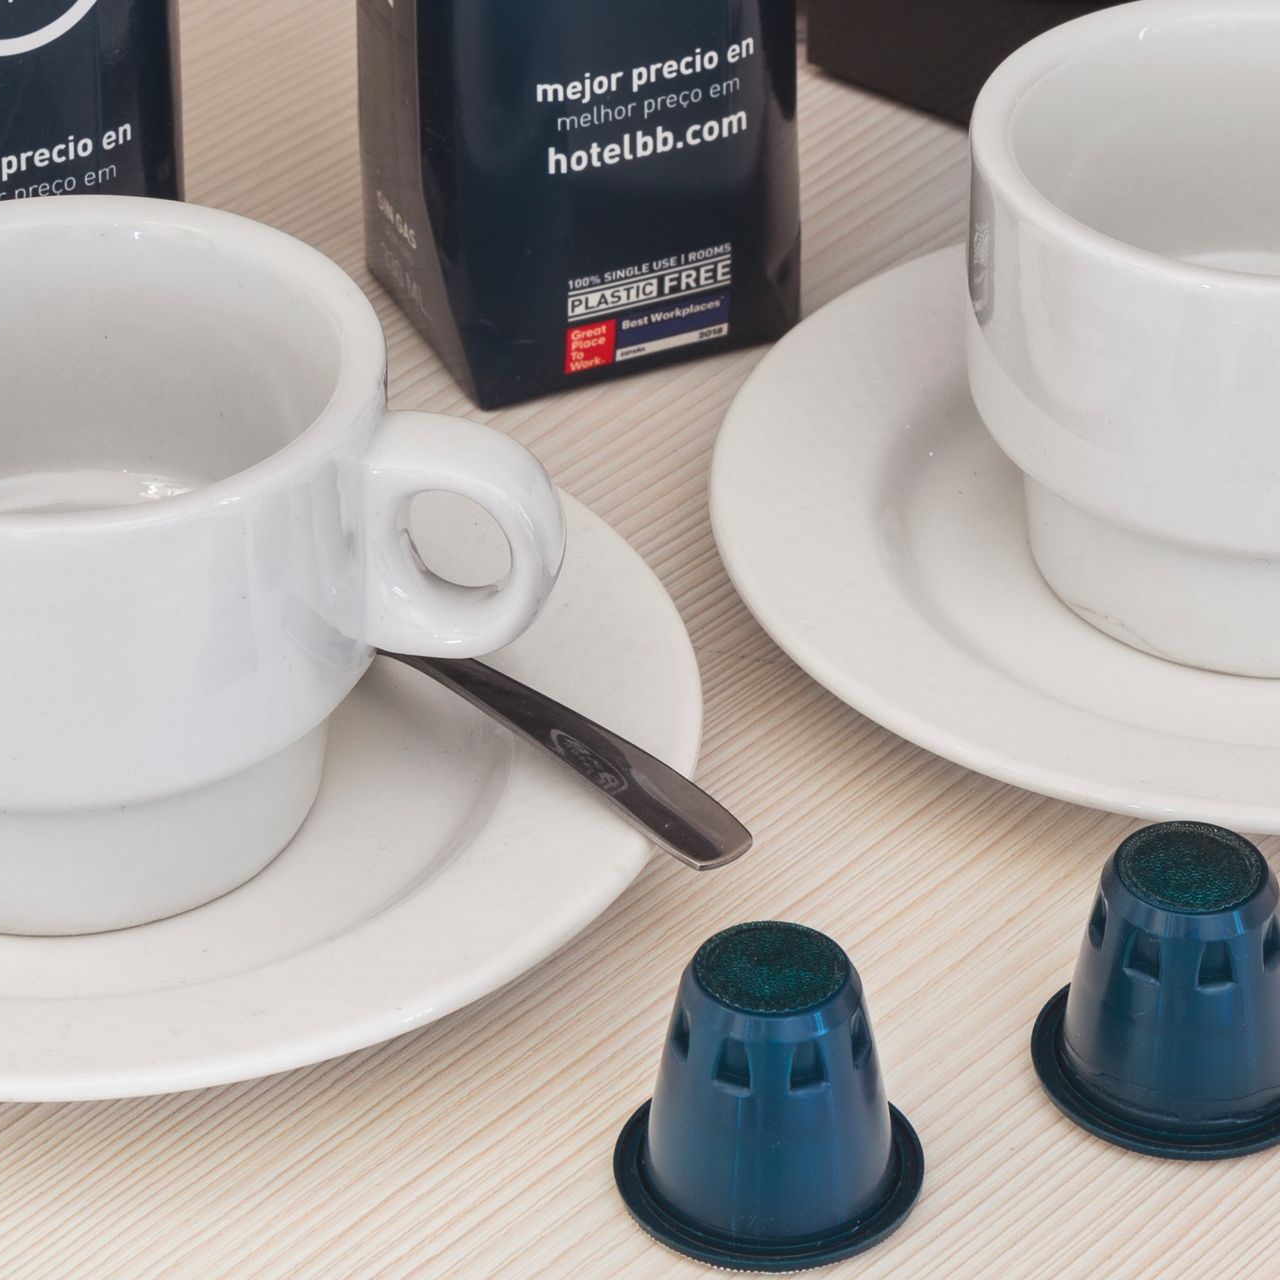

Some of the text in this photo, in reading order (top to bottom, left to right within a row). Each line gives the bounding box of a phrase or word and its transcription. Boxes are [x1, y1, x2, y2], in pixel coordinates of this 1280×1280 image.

[536, 36, 754, 104] mejor precio en
[557, 77, 740, 131] melhor preço em
[1, 136, 94, 181] precio
[102, 123, 132, 150] en
[548, 110, 747, 175] hotelbb.com
[84, 165, 117, 186] em
[568, 242, 731, 289] 100% SINGLE USE ROOMS
[570, 260, 732, 314] PLASTIC FREE
[571, 325, 607, 340] Great
[571, 336, 605, 351] Place
[622, 315, 649, 330] Best
[571, 351, 584, 361] To
